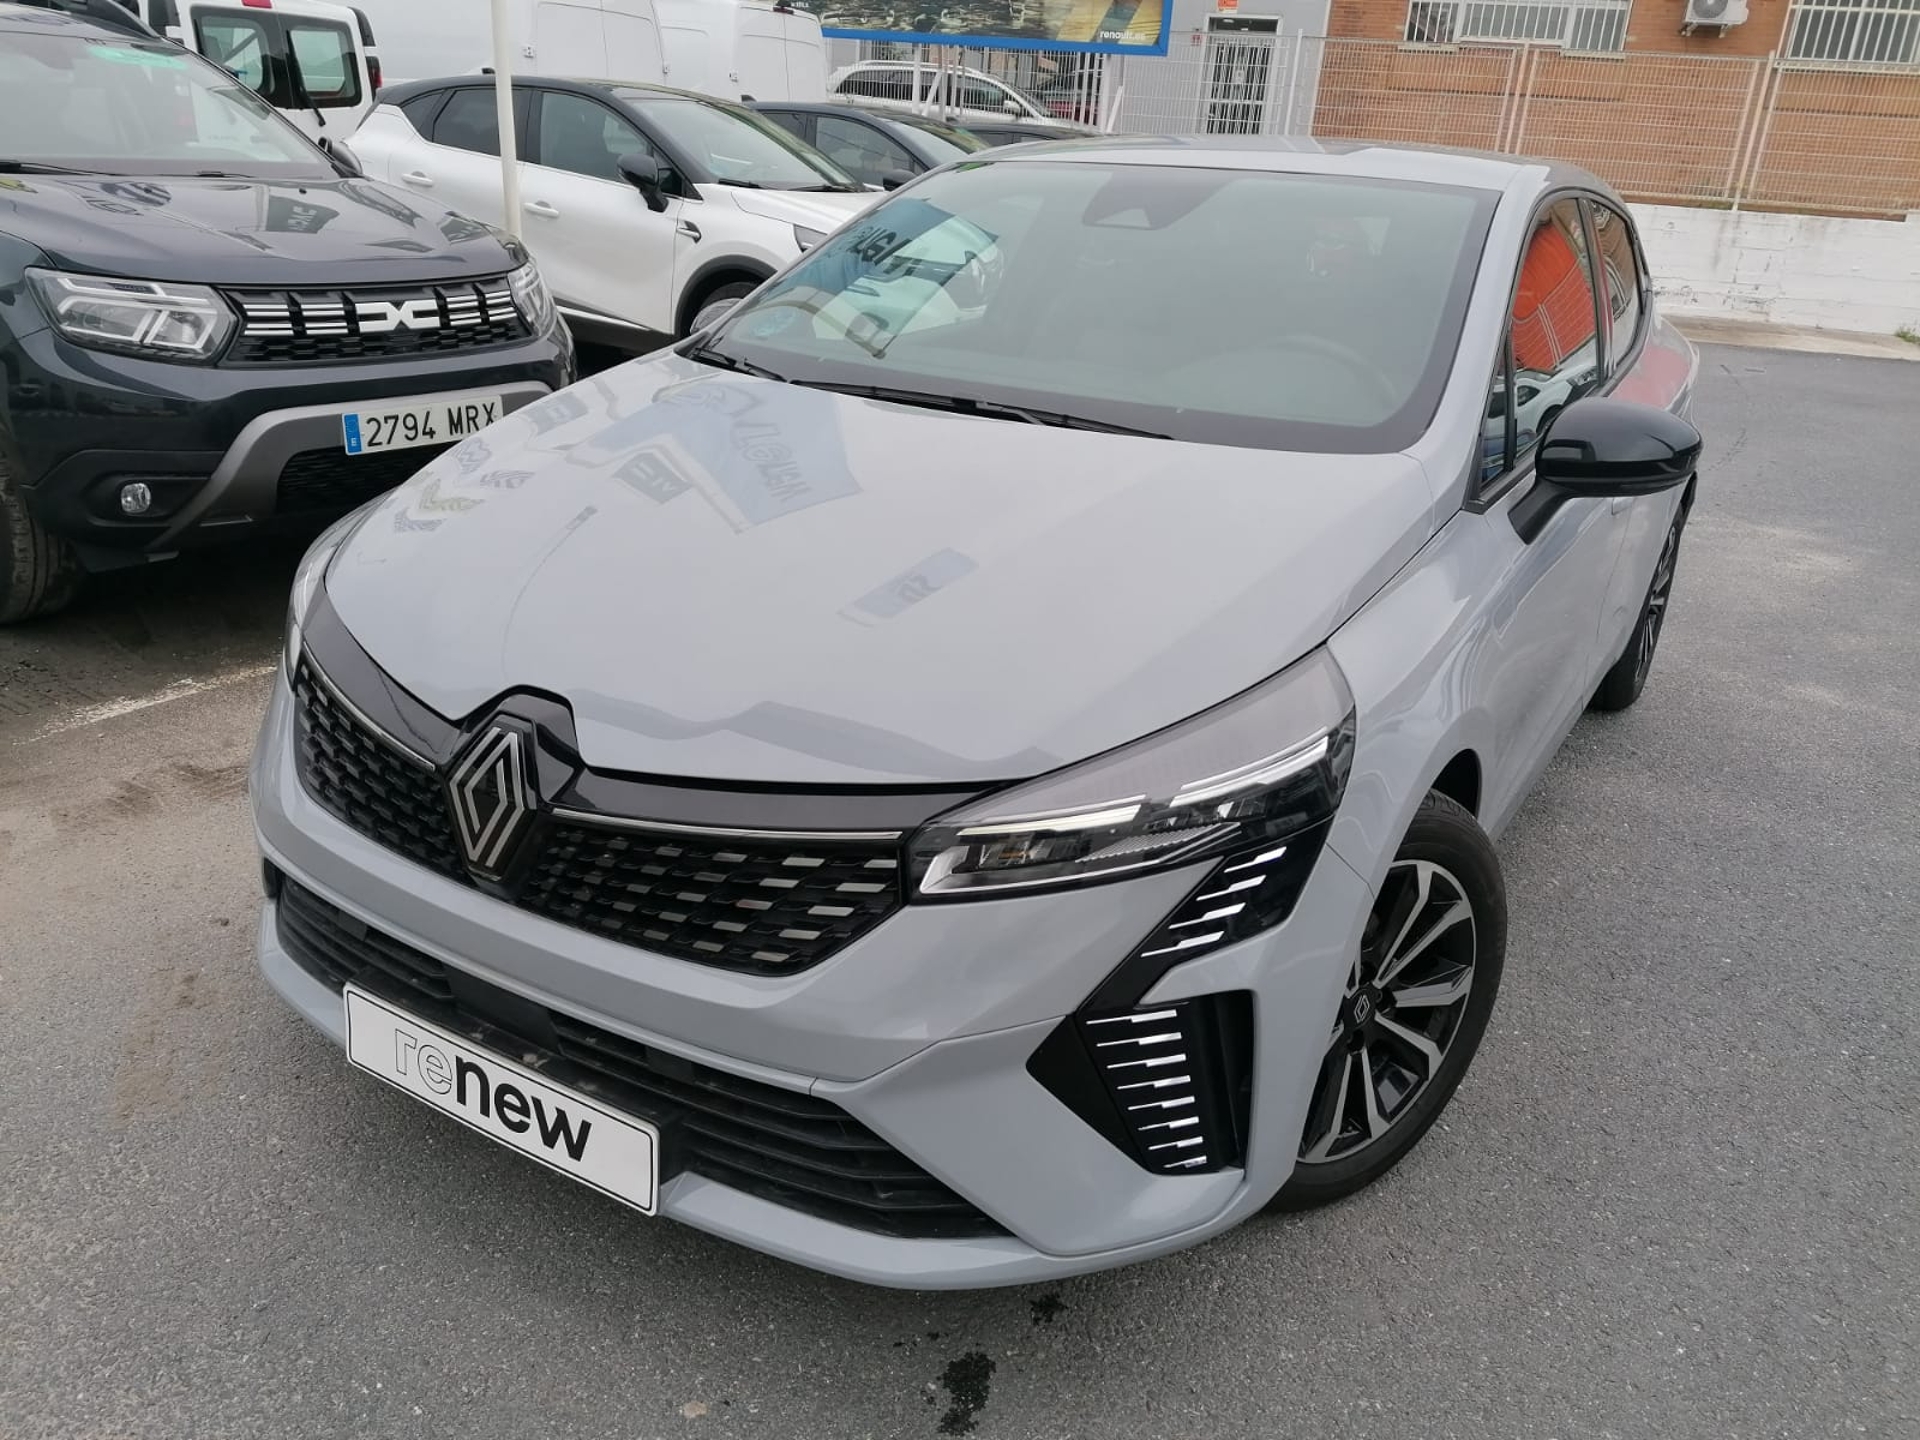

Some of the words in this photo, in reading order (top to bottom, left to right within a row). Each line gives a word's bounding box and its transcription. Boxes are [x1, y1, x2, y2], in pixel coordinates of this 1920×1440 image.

[365, 410, 436, 447] 2794
[447, 402, 496, 436] MRX
[394, 1028, 593, 1163] renew
